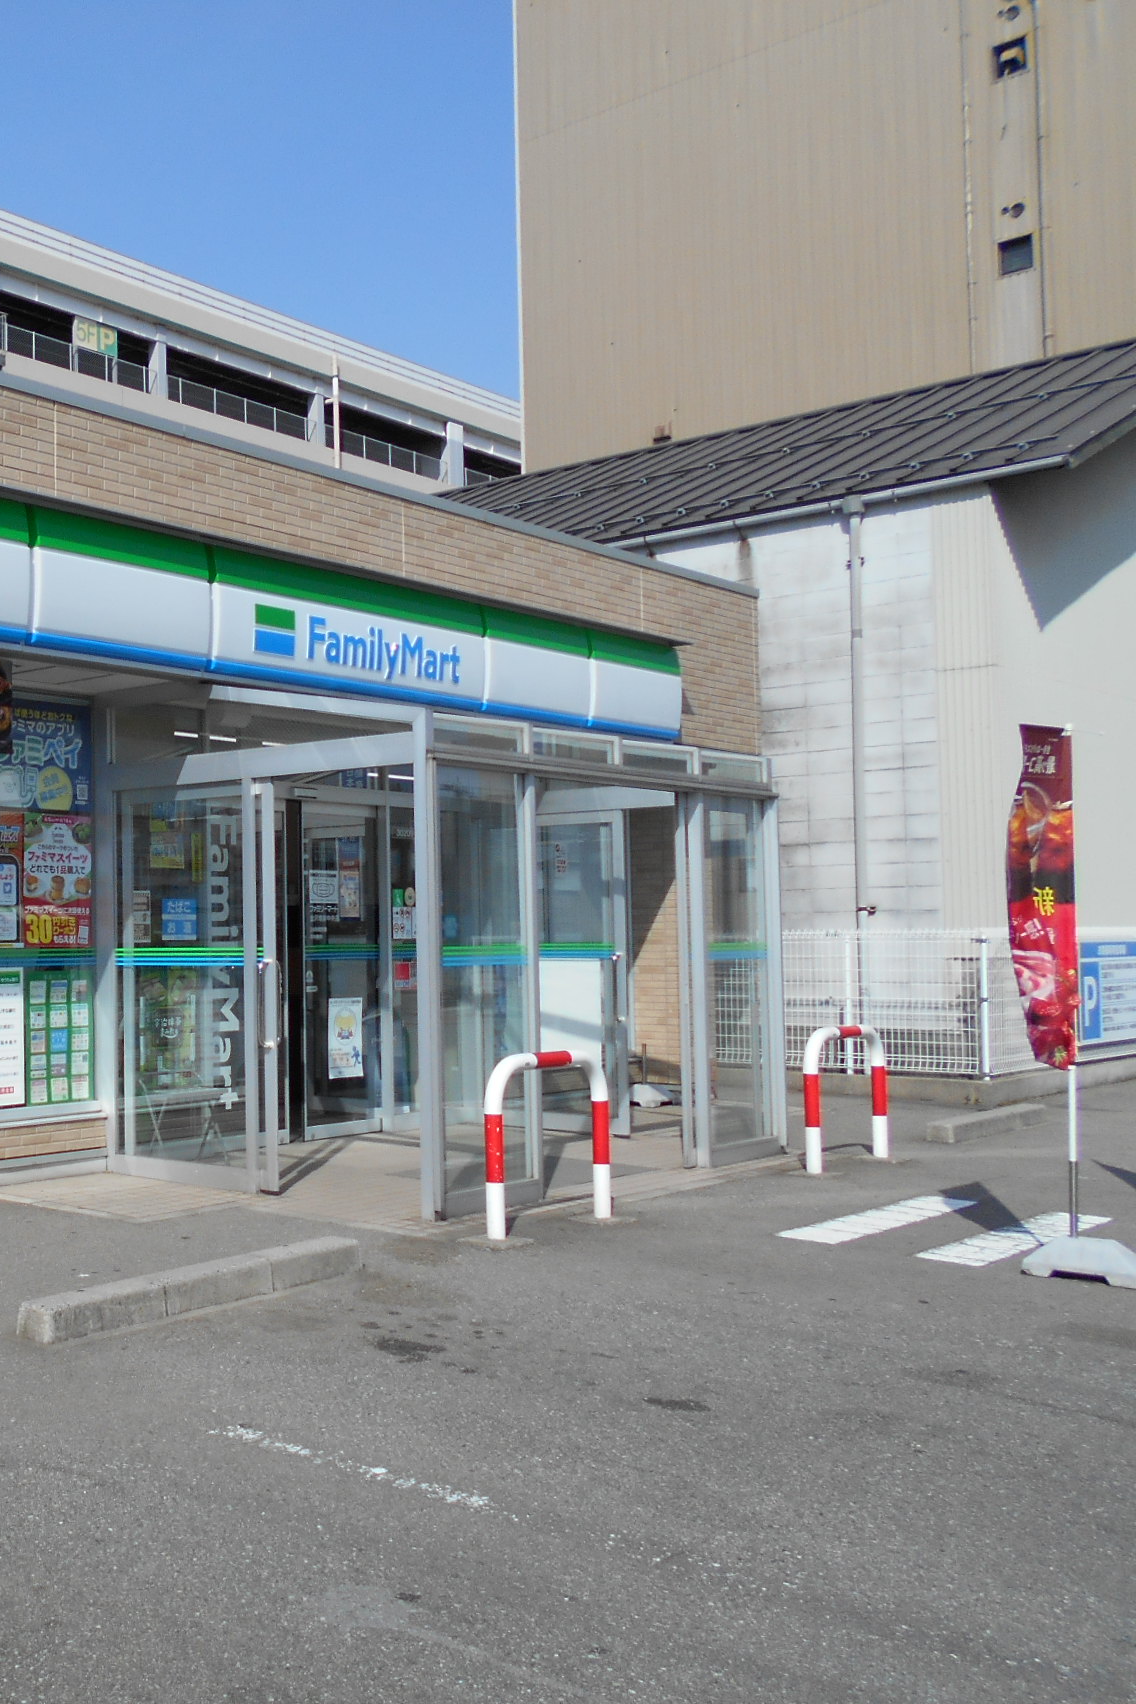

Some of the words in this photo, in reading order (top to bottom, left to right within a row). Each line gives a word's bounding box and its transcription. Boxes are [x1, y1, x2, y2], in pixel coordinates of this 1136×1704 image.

[100, 326, 116, 351] P
[306, 614, 461, 684] FamilyMart
[26, 914, 53, 944] 30
[1084, 976, 1097, 1027] P
